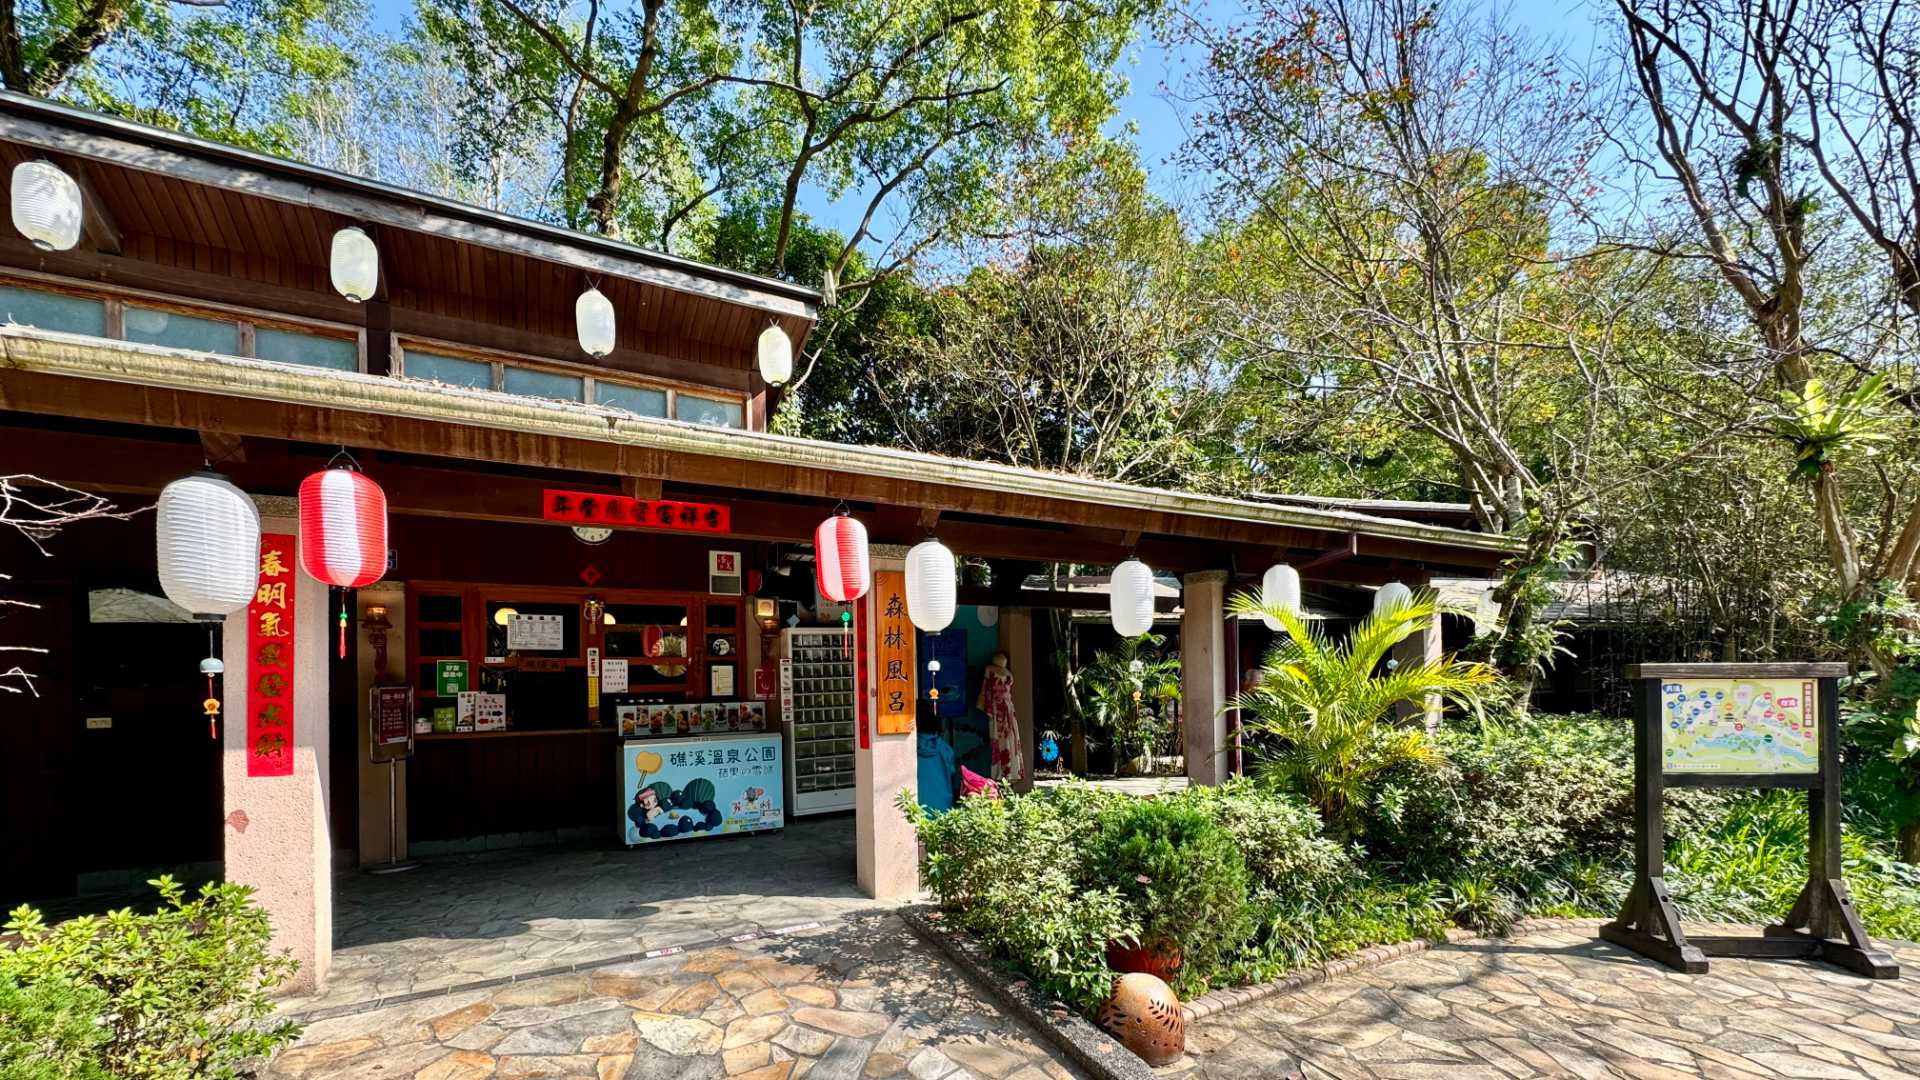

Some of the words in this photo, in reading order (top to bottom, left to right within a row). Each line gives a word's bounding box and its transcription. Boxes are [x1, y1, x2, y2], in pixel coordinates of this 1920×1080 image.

[883, 592, 908, 713] 森林風呂
[670, 746, 776, 767] 礁溪溫泉公園
